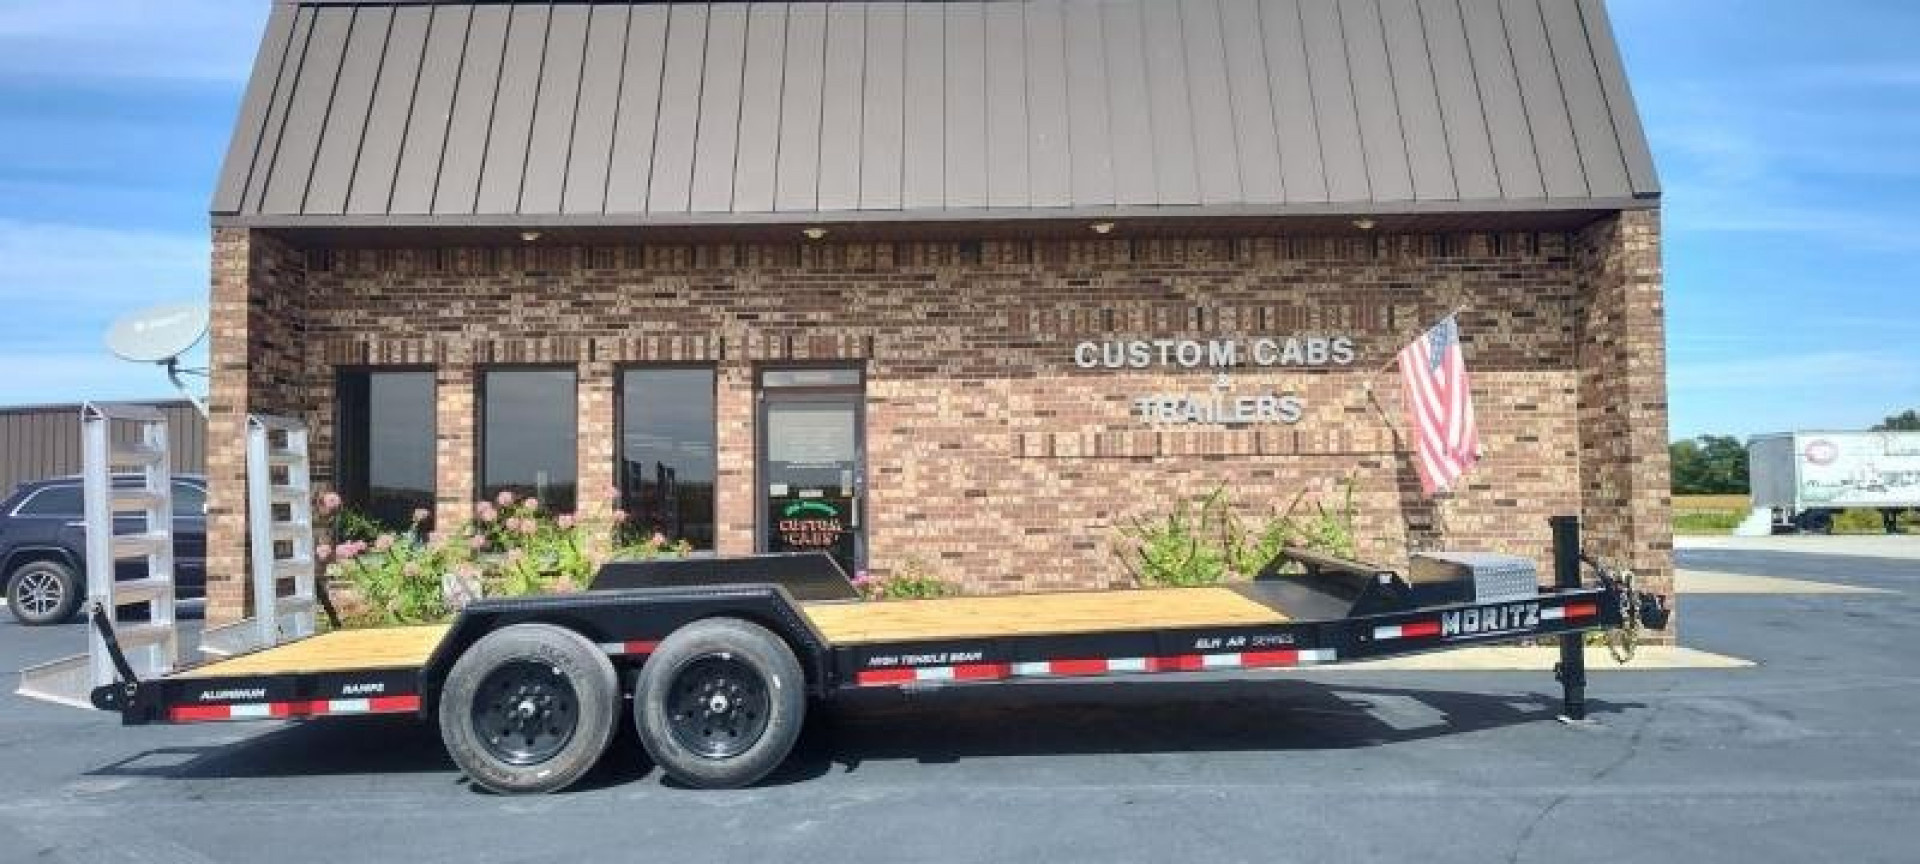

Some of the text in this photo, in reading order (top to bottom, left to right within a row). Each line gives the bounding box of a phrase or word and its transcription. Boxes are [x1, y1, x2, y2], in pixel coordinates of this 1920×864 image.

[1074, 336, 1355, 368] CUSTOM CABS
[1134, 393, 1303, 424] TRAILERS
[779, 519, 843, 532] CUSTOM
[1441, 603, 1540, 637] MORITZ
[1226, 635, 1247, 648] AR
[1252, 633, 1295, 646] SERIES
[868, 651, 983, 666] HIGH TENSILE BEAM
[200, 687, 266, 701] ALUMINUM
[342, 683, 385, 695] RAMPS
